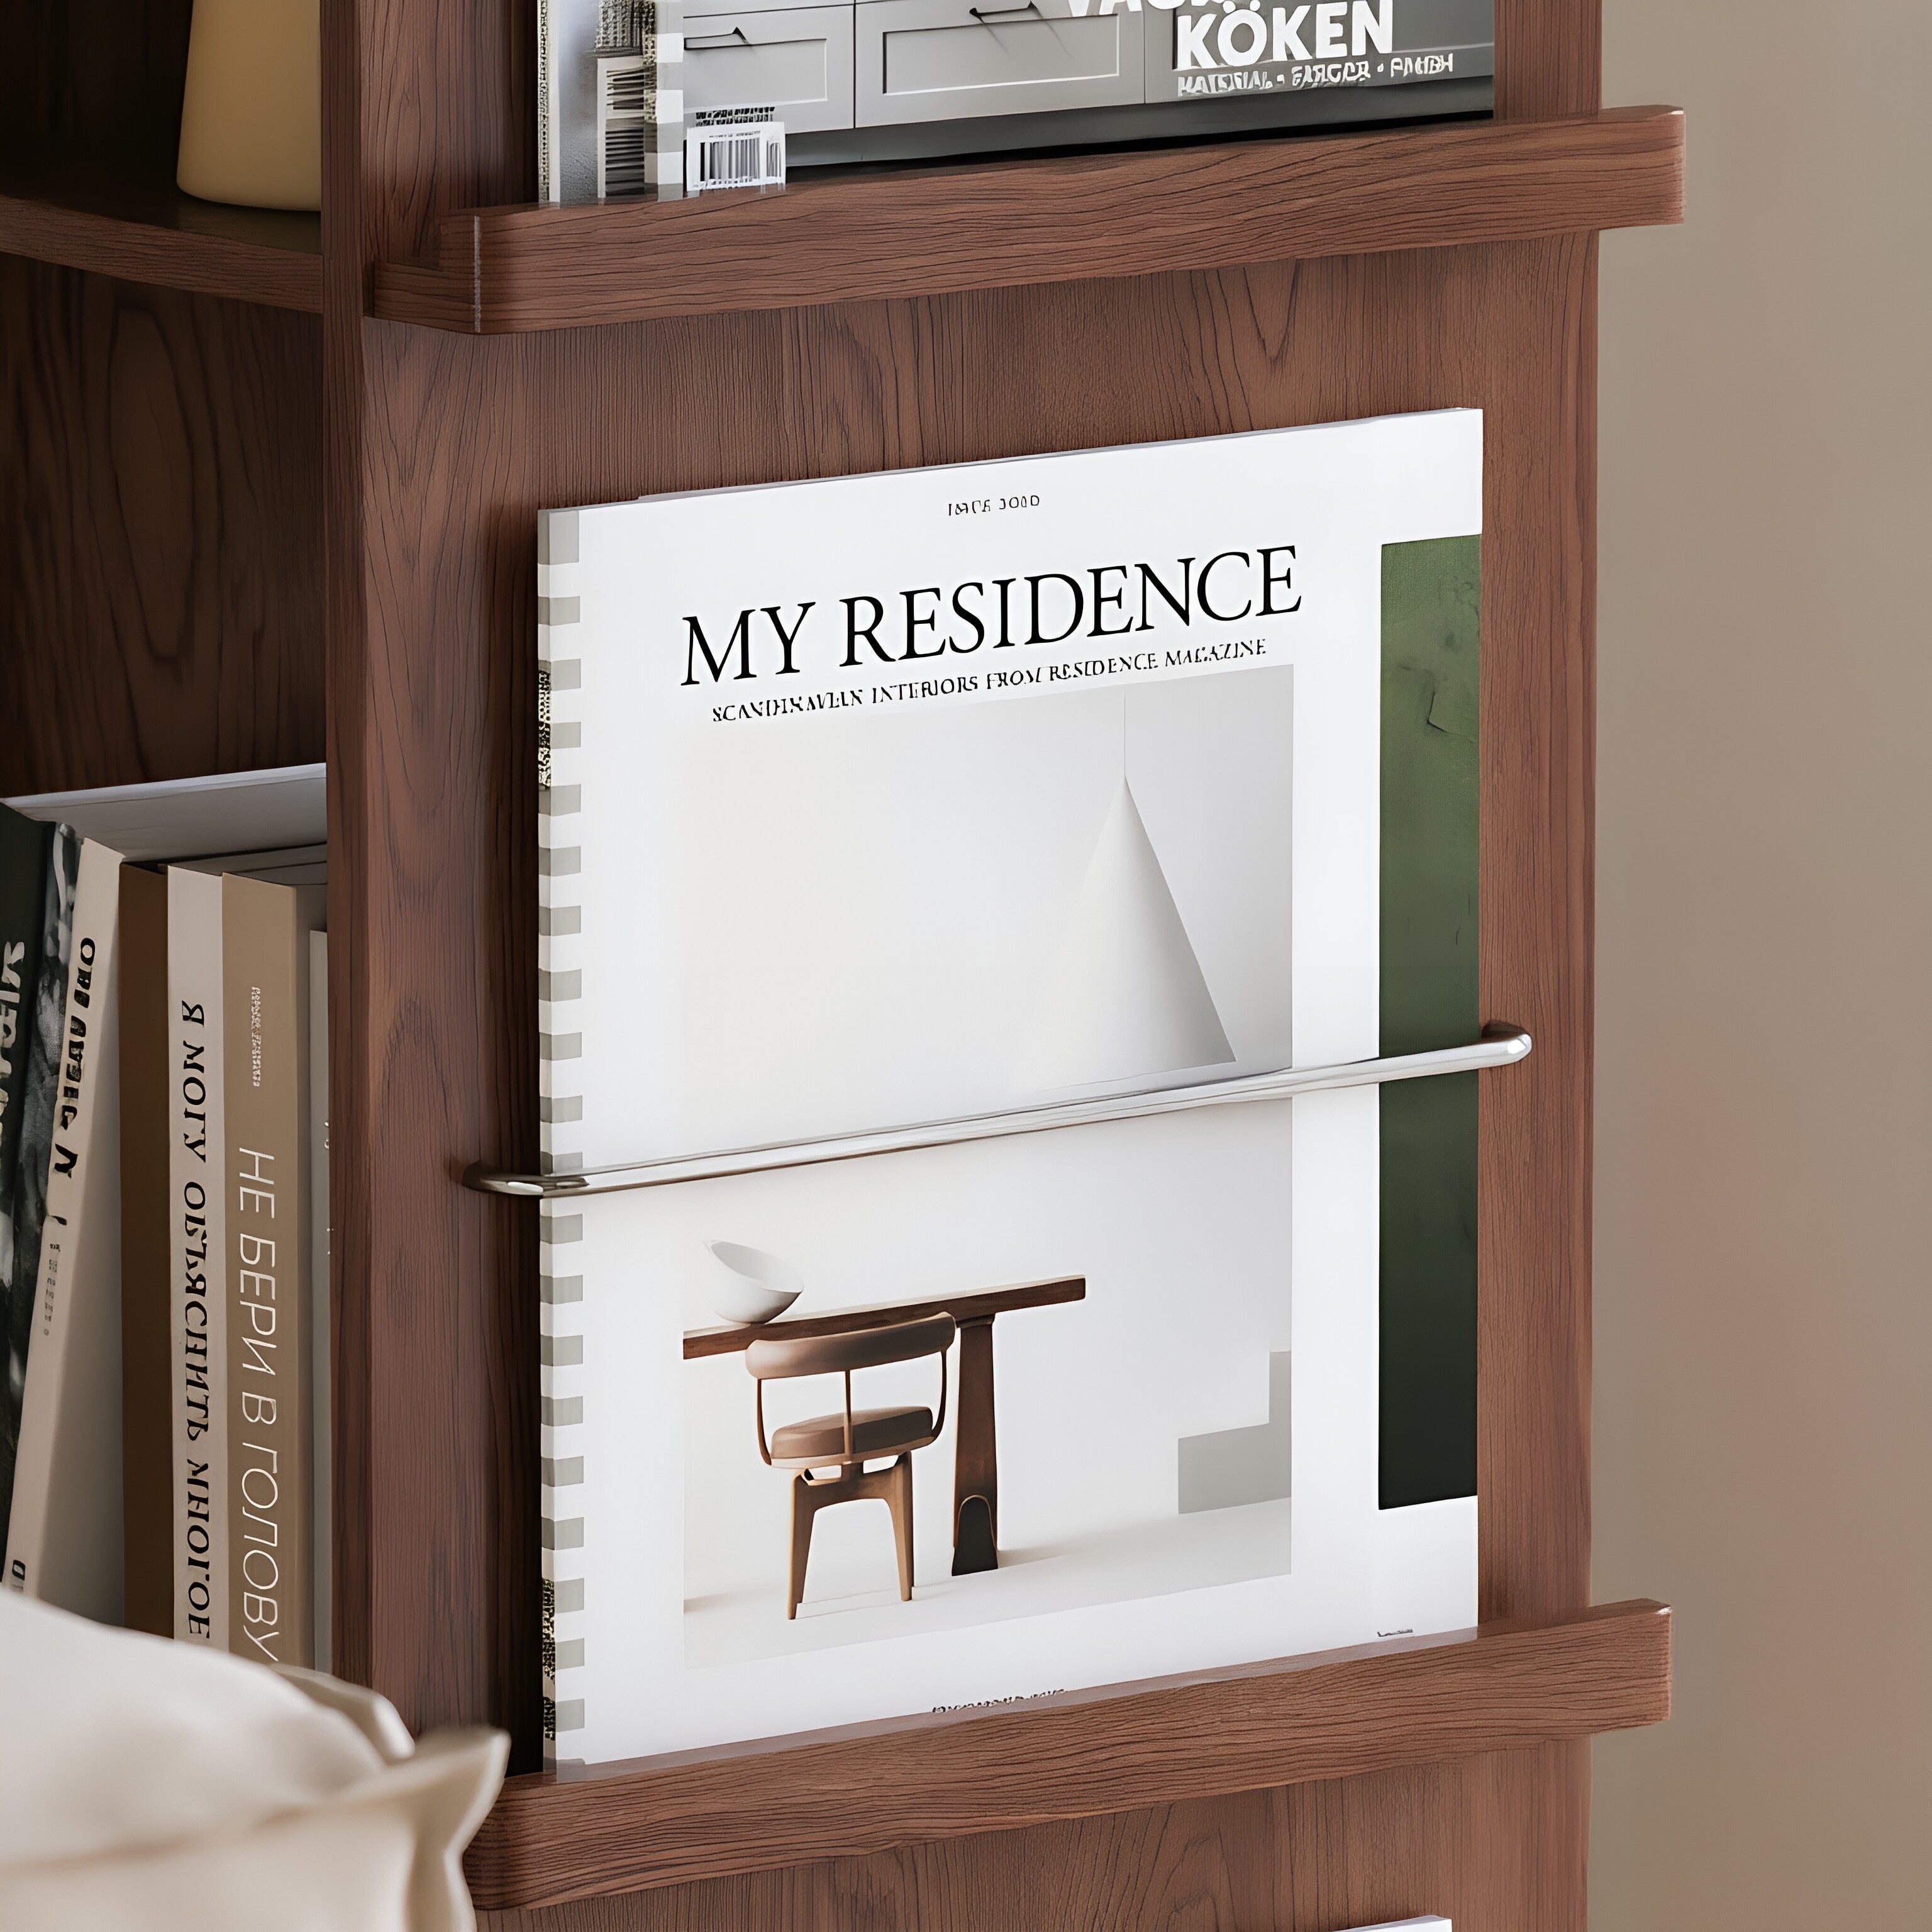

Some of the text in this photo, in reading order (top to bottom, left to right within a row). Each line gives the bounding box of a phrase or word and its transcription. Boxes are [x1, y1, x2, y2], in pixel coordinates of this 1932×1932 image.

[1177, 0, 1392, 70] KÖKEN
[680, 545, 1302, 686] MY RESIDENCE
[1049, 653, 1158, 681] RESIDENCE
[181, 1000, 204, 1028] Я
[182, 1040, 206, 1163] МОГУ
[239, 1146, 279, 1662] НЕ БЕРИ В ГОЛОВУ
[187, 1458, 210, 1639] МНОГОЕ
